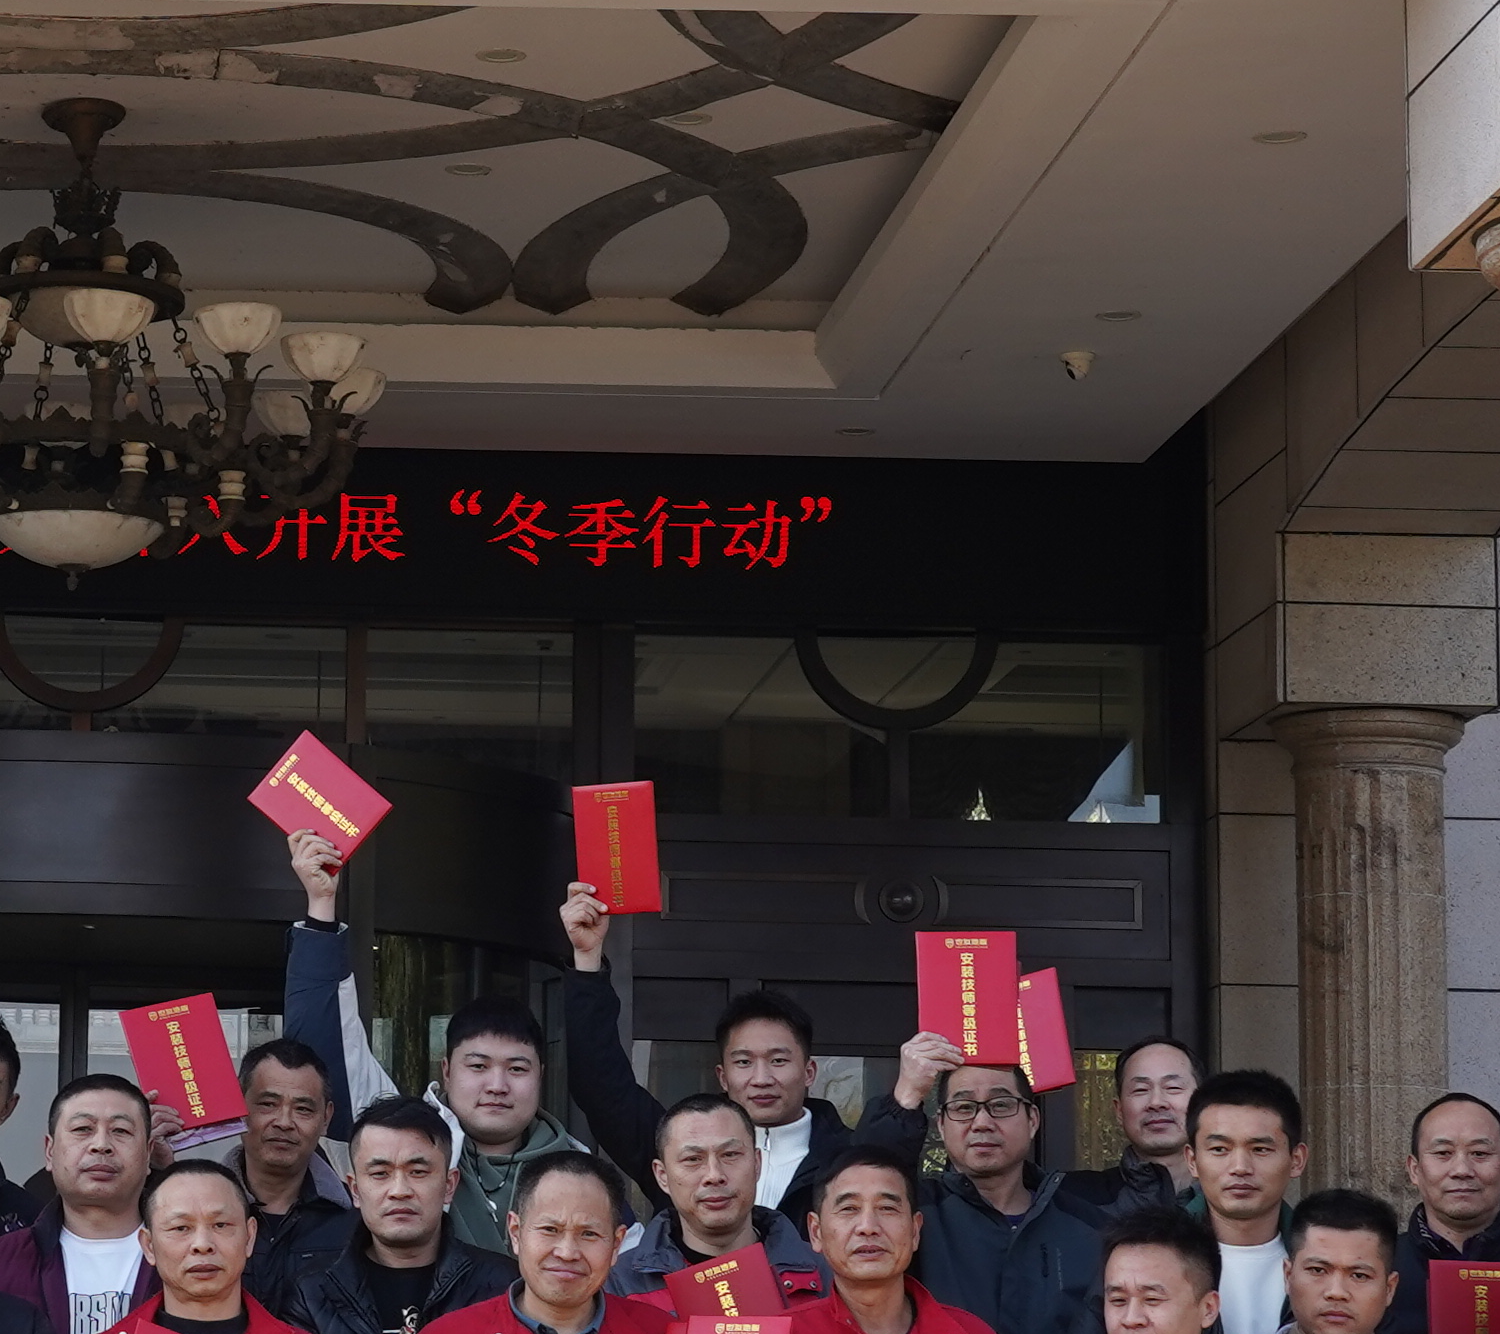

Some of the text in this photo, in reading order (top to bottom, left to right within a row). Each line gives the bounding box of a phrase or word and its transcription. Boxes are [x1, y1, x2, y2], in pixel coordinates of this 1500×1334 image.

[960, 952, 978, 1056] 安装技师等级证书
[165, 1021, 206, 1118] 安装技师等级证书
